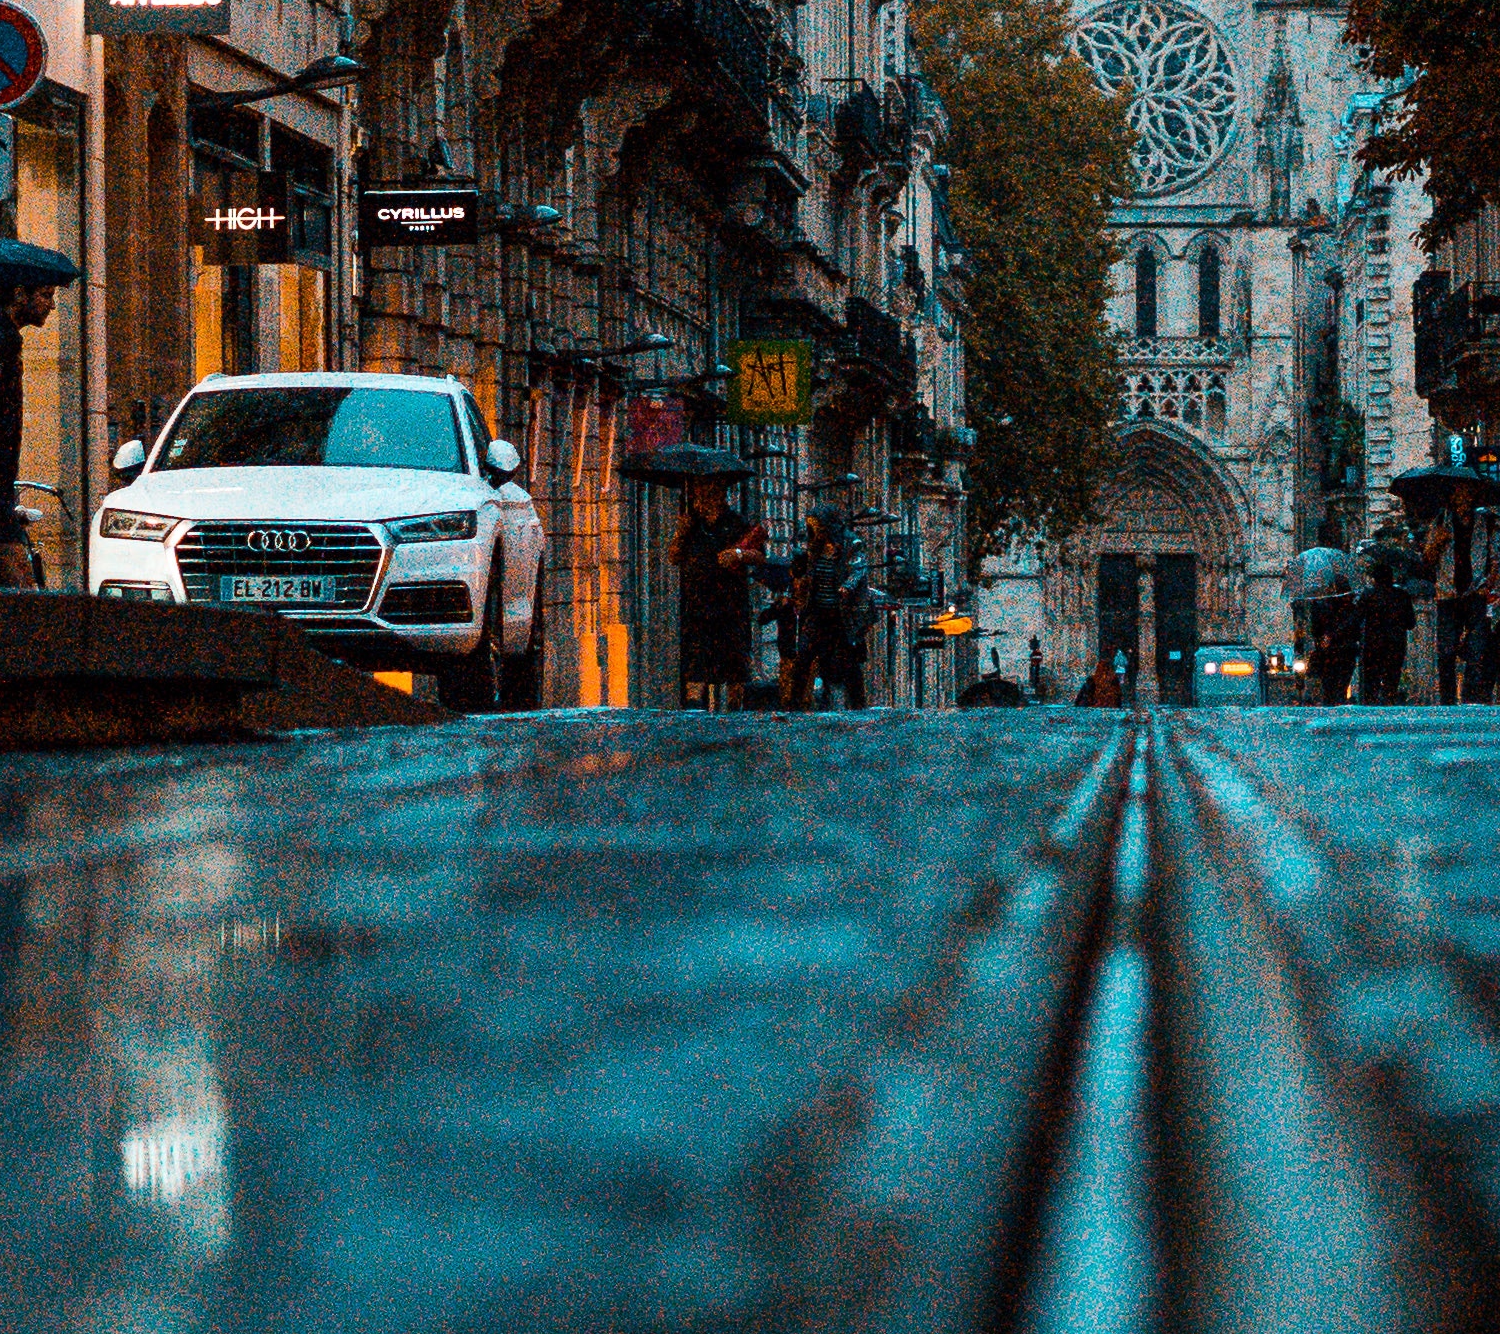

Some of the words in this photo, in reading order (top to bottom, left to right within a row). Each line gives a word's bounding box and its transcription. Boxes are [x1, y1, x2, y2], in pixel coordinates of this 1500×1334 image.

[213, 206, 277, 231] HIGH
[377, 206, 466, 221] CYRILLUS
[233, 579, 322, 598] EL-212-BW
